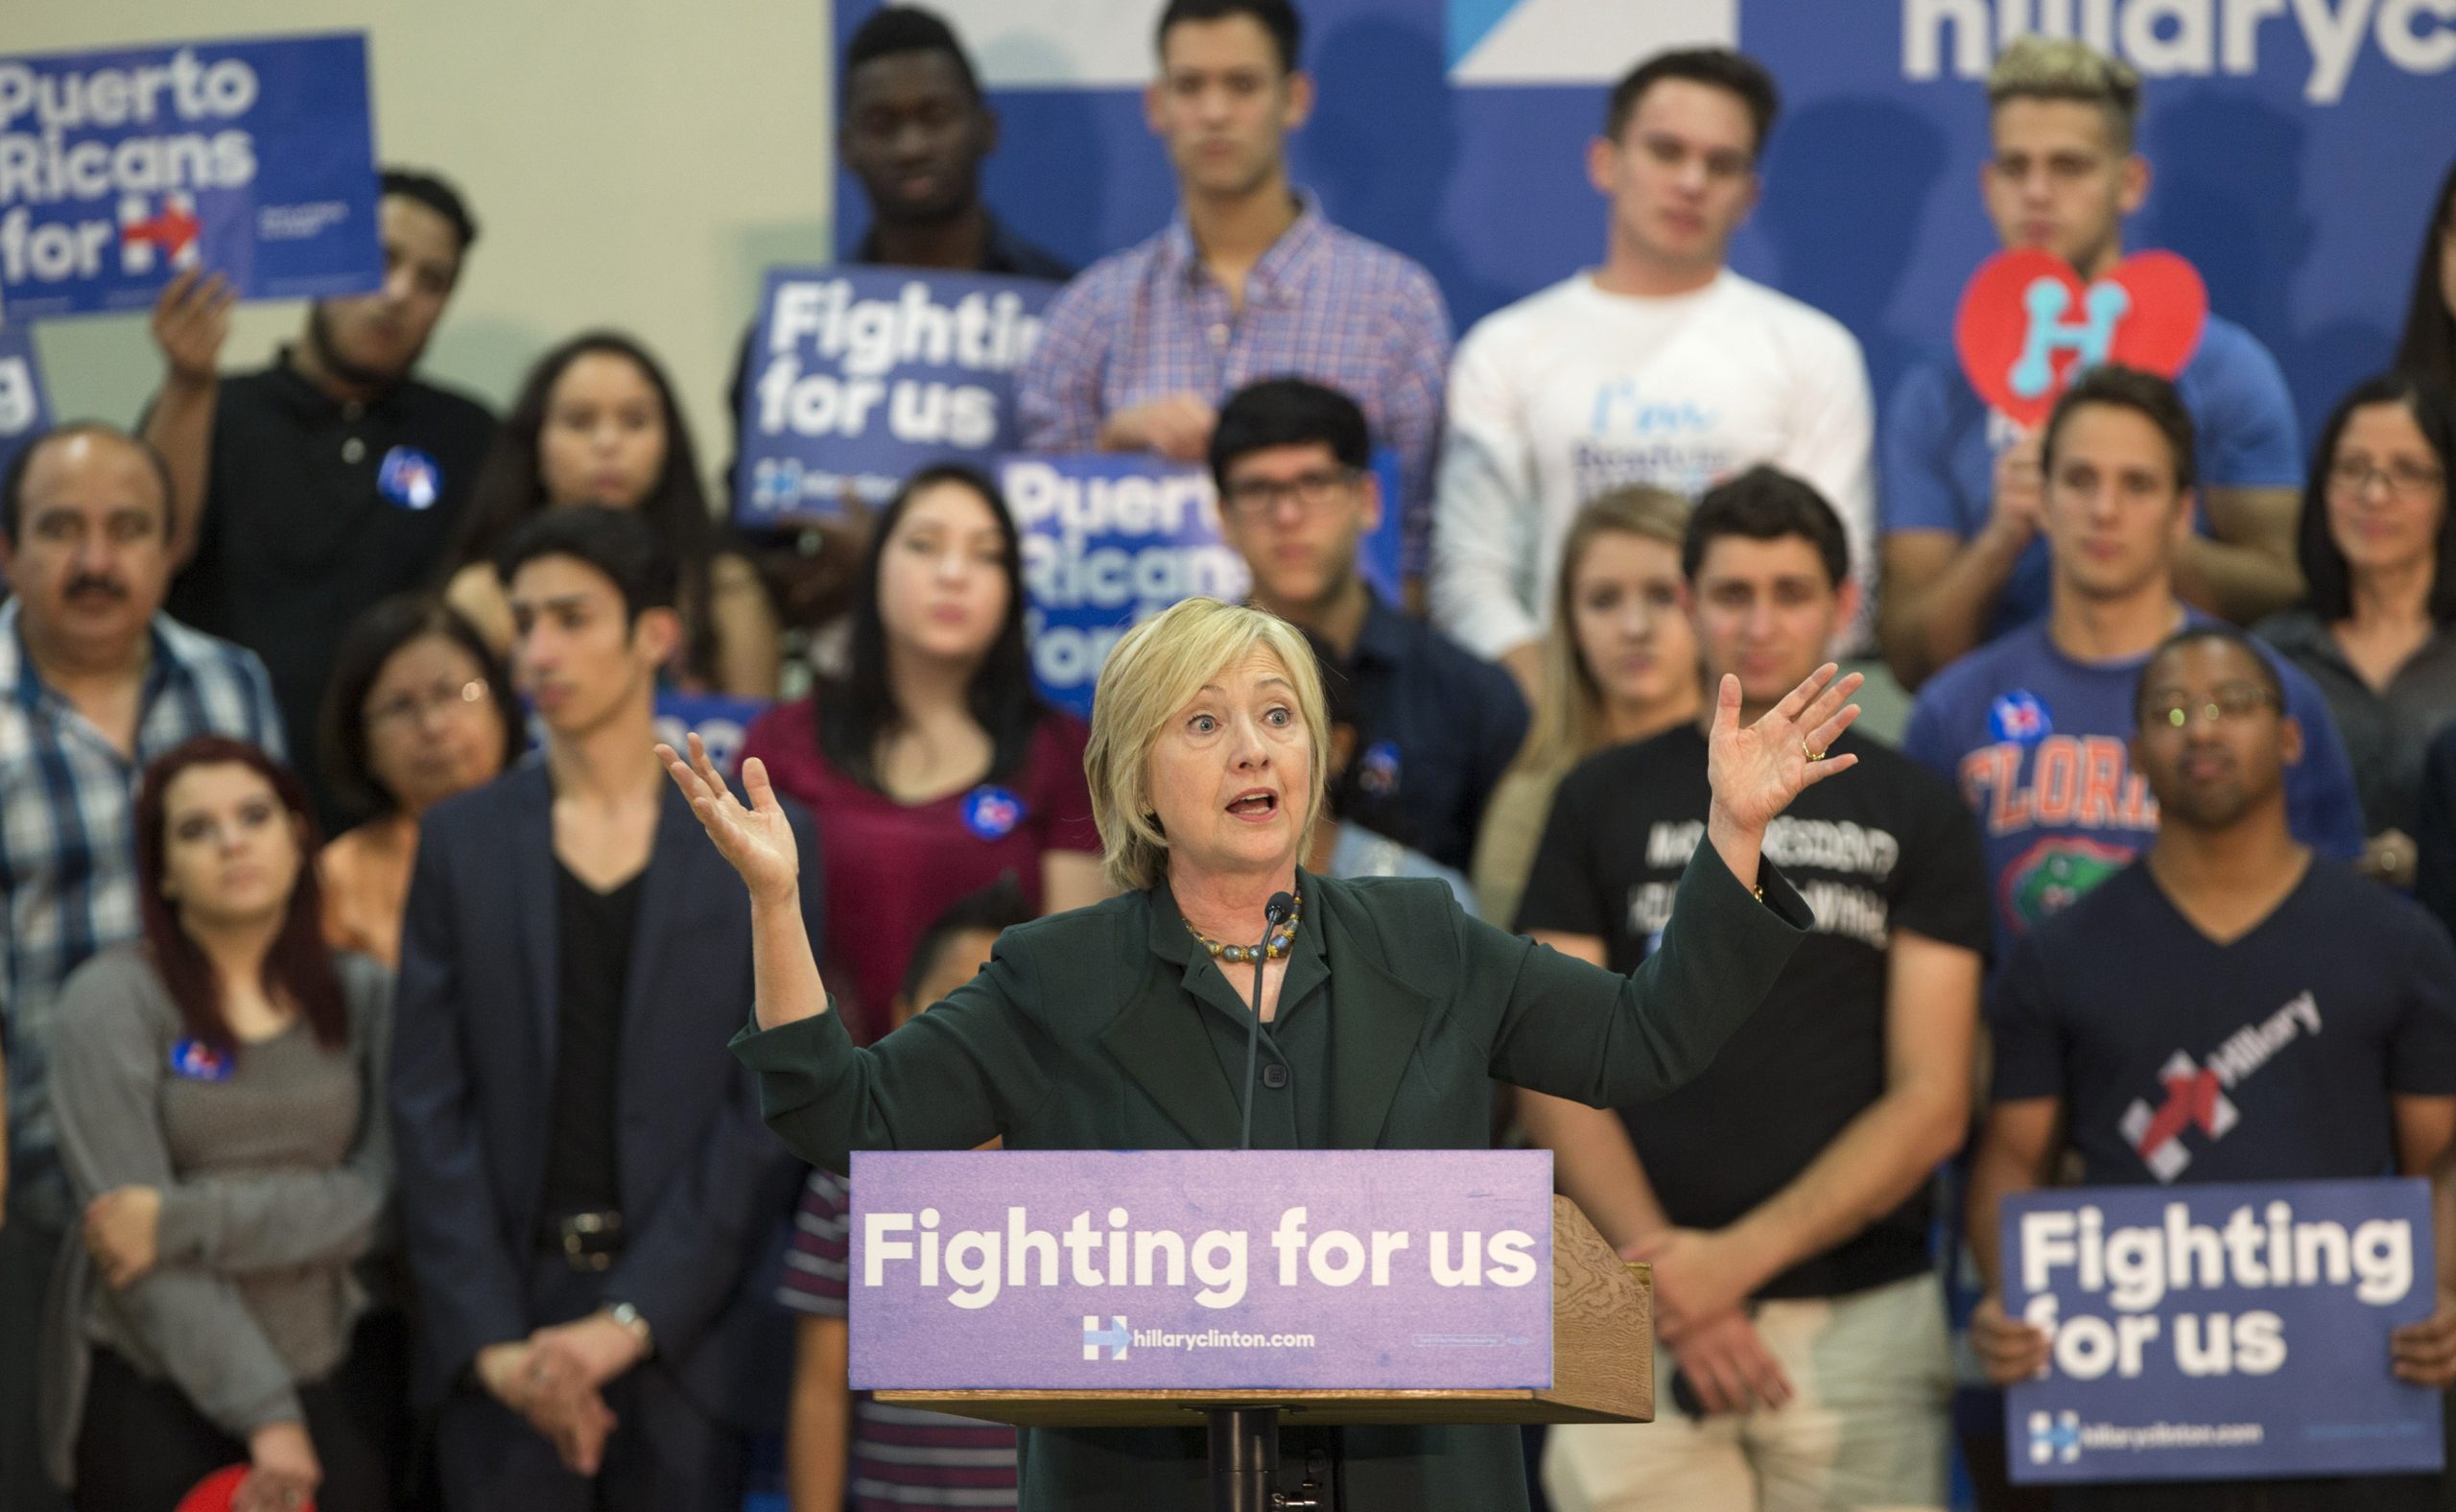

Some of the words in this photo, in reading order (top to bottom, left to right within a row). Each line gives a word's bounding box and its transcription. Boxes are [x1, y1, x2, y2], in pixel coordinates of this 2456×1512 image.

[0, 50, 258, 130] Puerto
[1901, 0, 2456, 105] haryc
[0, 128, 257, 201] Ricans
[2, 206, 112, 284] for
[771, 278, 1043, 378] Fighti
[760, 353, 886, 437] for
[888, 378, 999, 449] us
[1002, 461, 1219, 535] Puert
[1021, 531, 1255, 608] Rican
[1959, 734, 2161, 837] FLORI
[2206, 989, 2323, 1089] Hillary
[862, 1207, 1248, 1310] Fighting
[1271, 1206, 1408, 1288] for
[1429, 1229, 1537, 1288] us
[2019, 1200, 2414, 1312] Fighting
[1133, 1329, 1315, 1352] hillaryclinton.com
[2172, 1309, 2289, 1376] us
[2080, 1421, 2265, 1453] hillaryclinton.com
